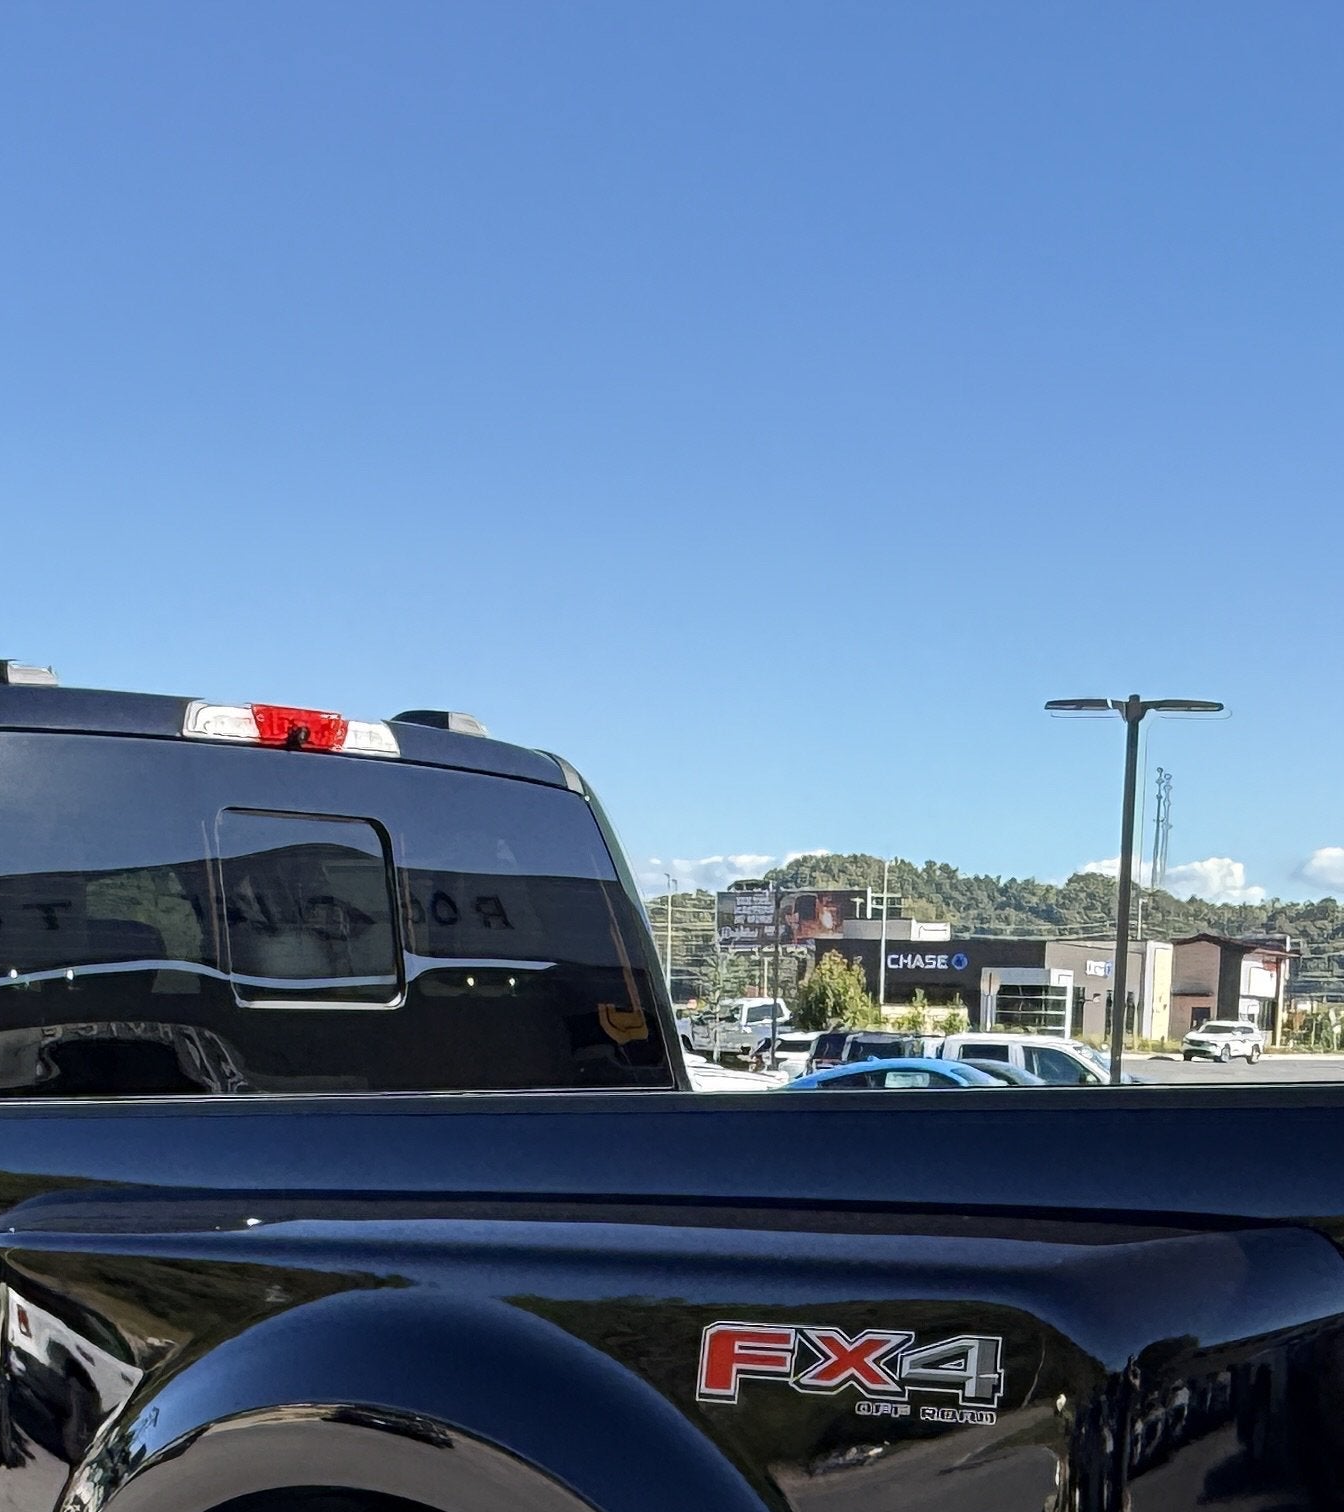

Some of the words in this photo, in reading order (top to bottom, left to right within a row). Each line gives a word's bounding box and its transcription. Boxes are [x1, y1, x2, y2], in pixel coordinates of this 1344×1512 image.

[886, 953, 949, 970] CHASE
[695, 1320, 1004, 1407] FX4
[854, 1400, 911, 1418] OFF
[919, 1405, 998, 1426] ROAD
